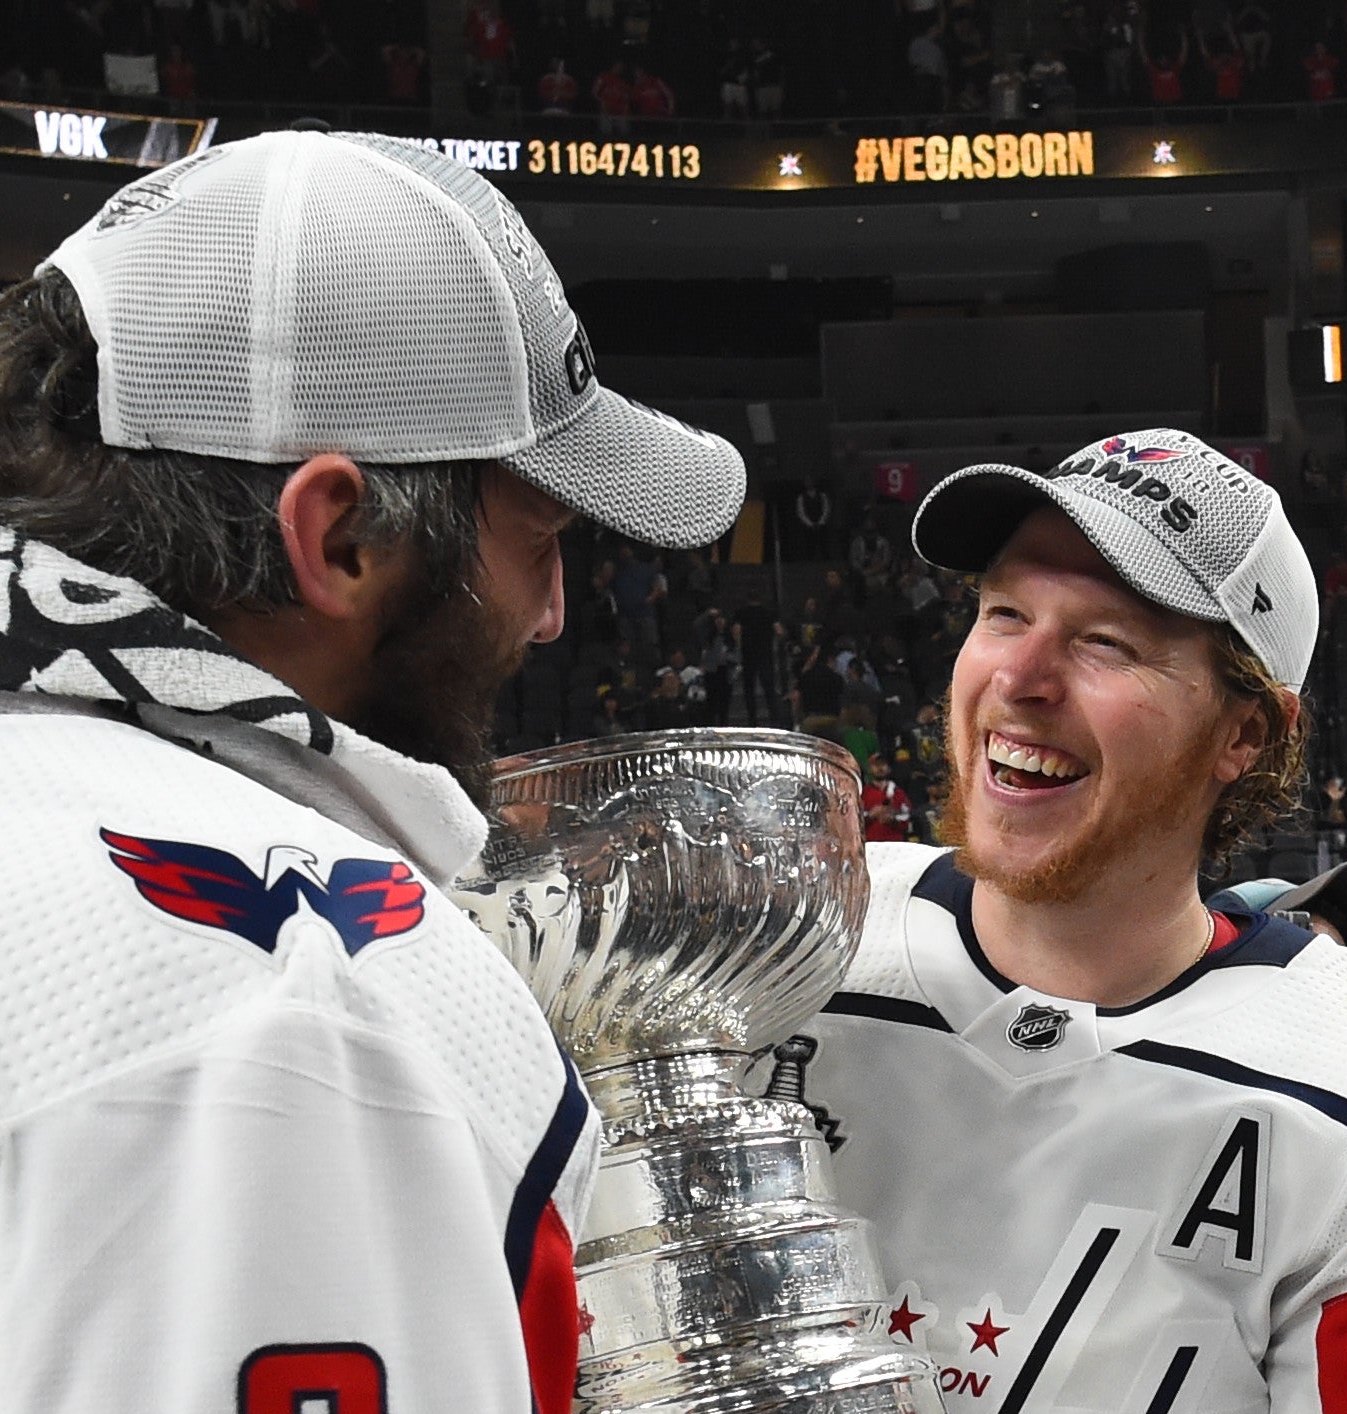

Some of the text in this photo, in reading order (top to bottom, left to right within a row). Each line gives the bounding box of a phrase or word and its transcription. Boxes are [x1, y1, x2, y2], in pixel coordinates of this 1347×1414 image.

[34, 110, 108, 158] VGK
[855, 131, 1094, 183] #VEGASBORN
[528, 140, 701, 179] 3116474113
[1045, 457, 1199, 533] AMPS
[1018, 1018, 1058, 1038] NHL
[1172, 1117, 1260, 1262] A
[938, 1367, 992, 1397] ON
